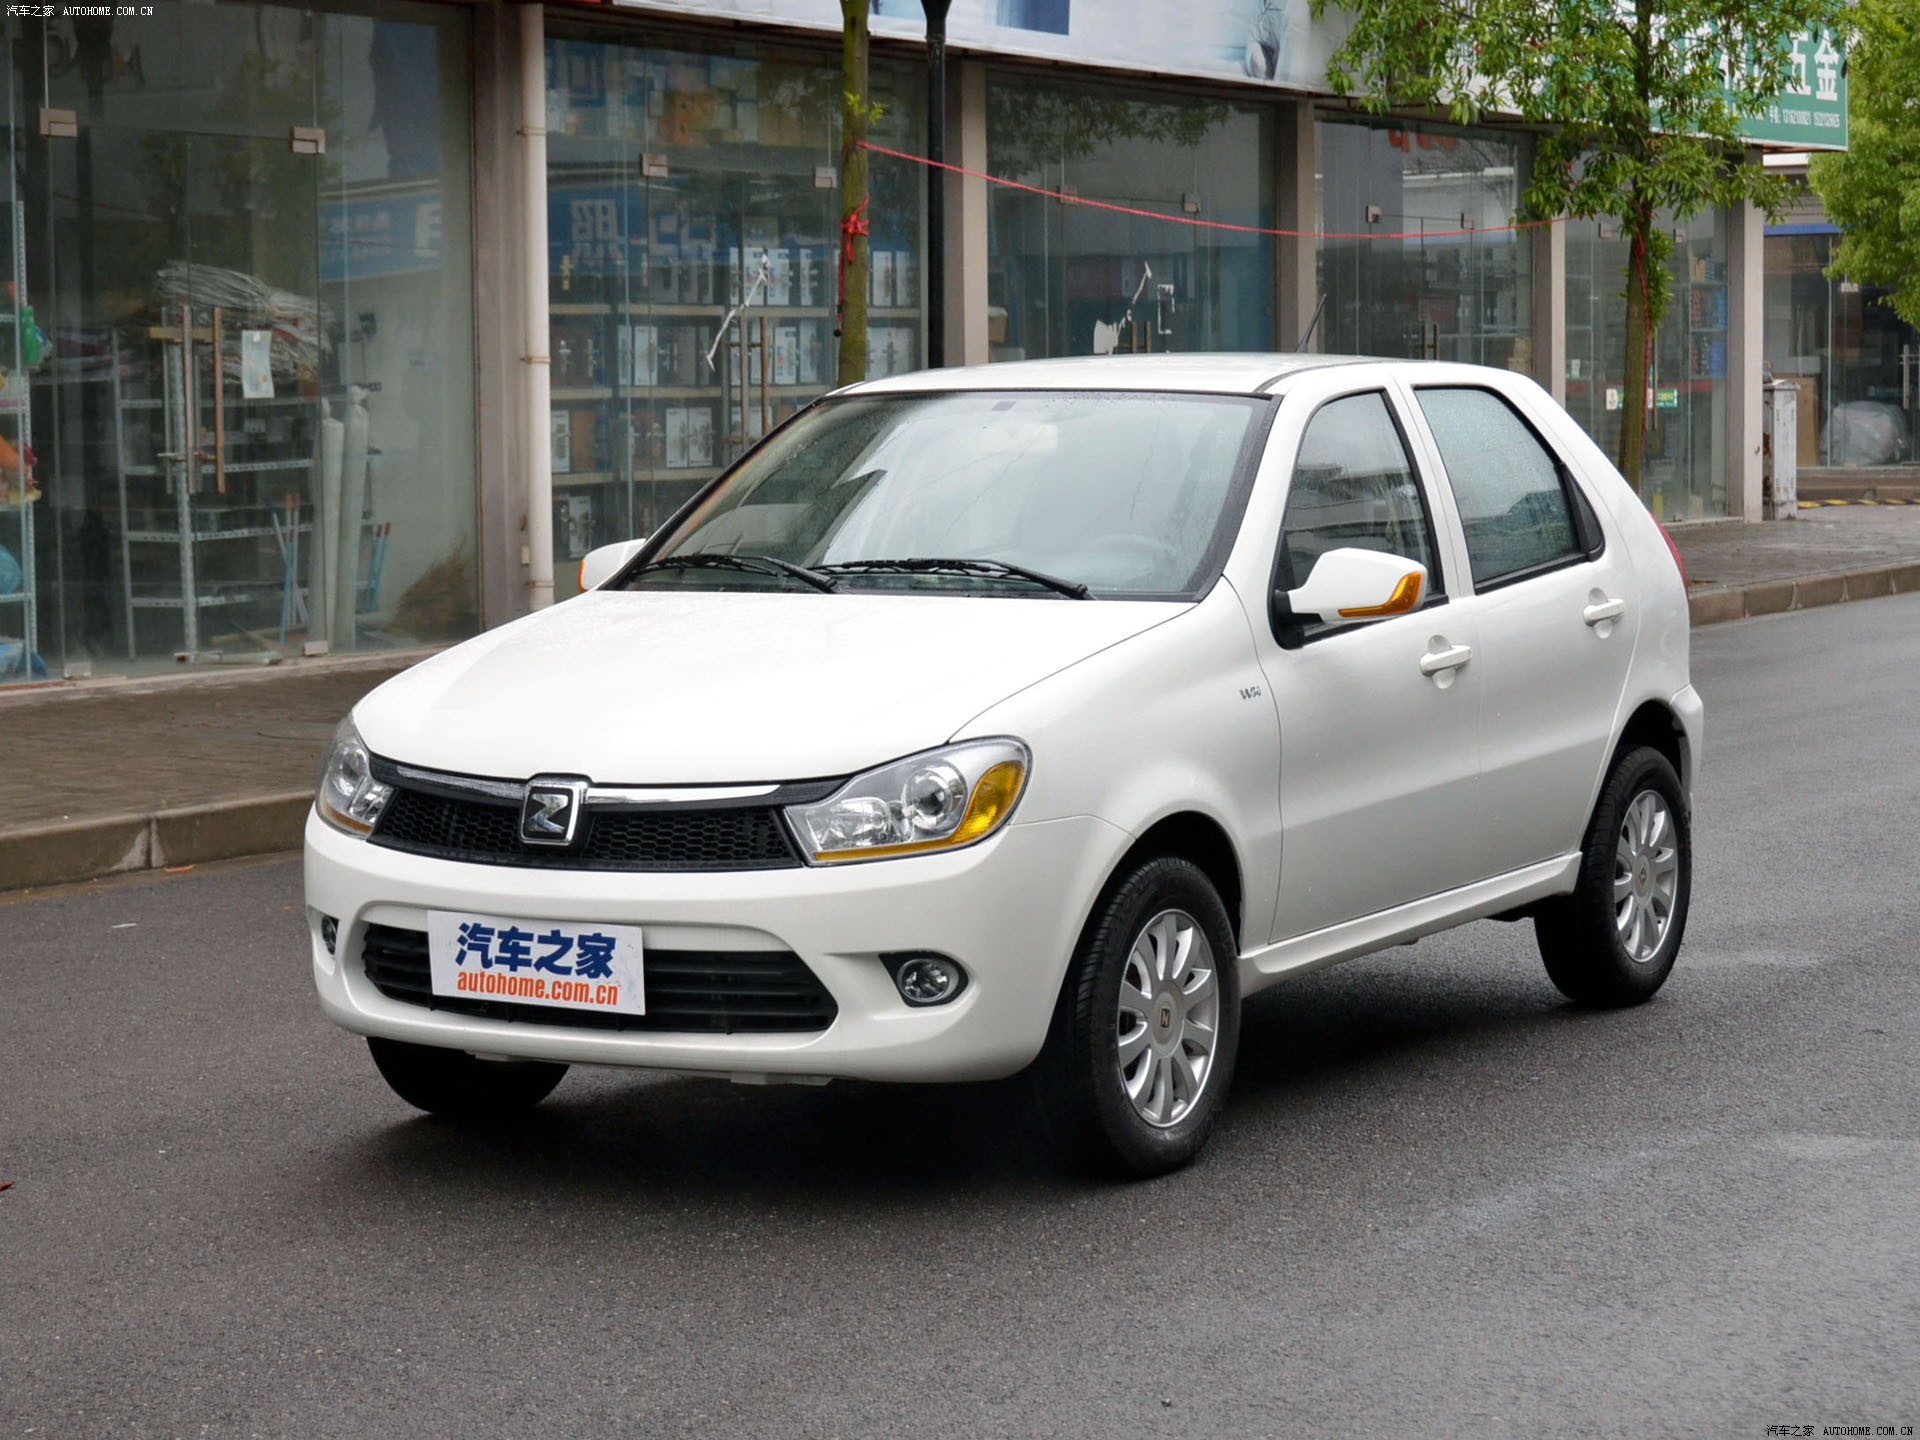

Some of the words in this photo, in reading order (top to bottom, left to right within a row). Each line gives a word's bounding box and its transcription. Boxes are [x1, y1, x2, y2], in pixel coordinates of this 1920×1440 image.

[455, 922, 616, 979] 汽车之家
[457, 971, 618, 1005] autohome.com.cn
